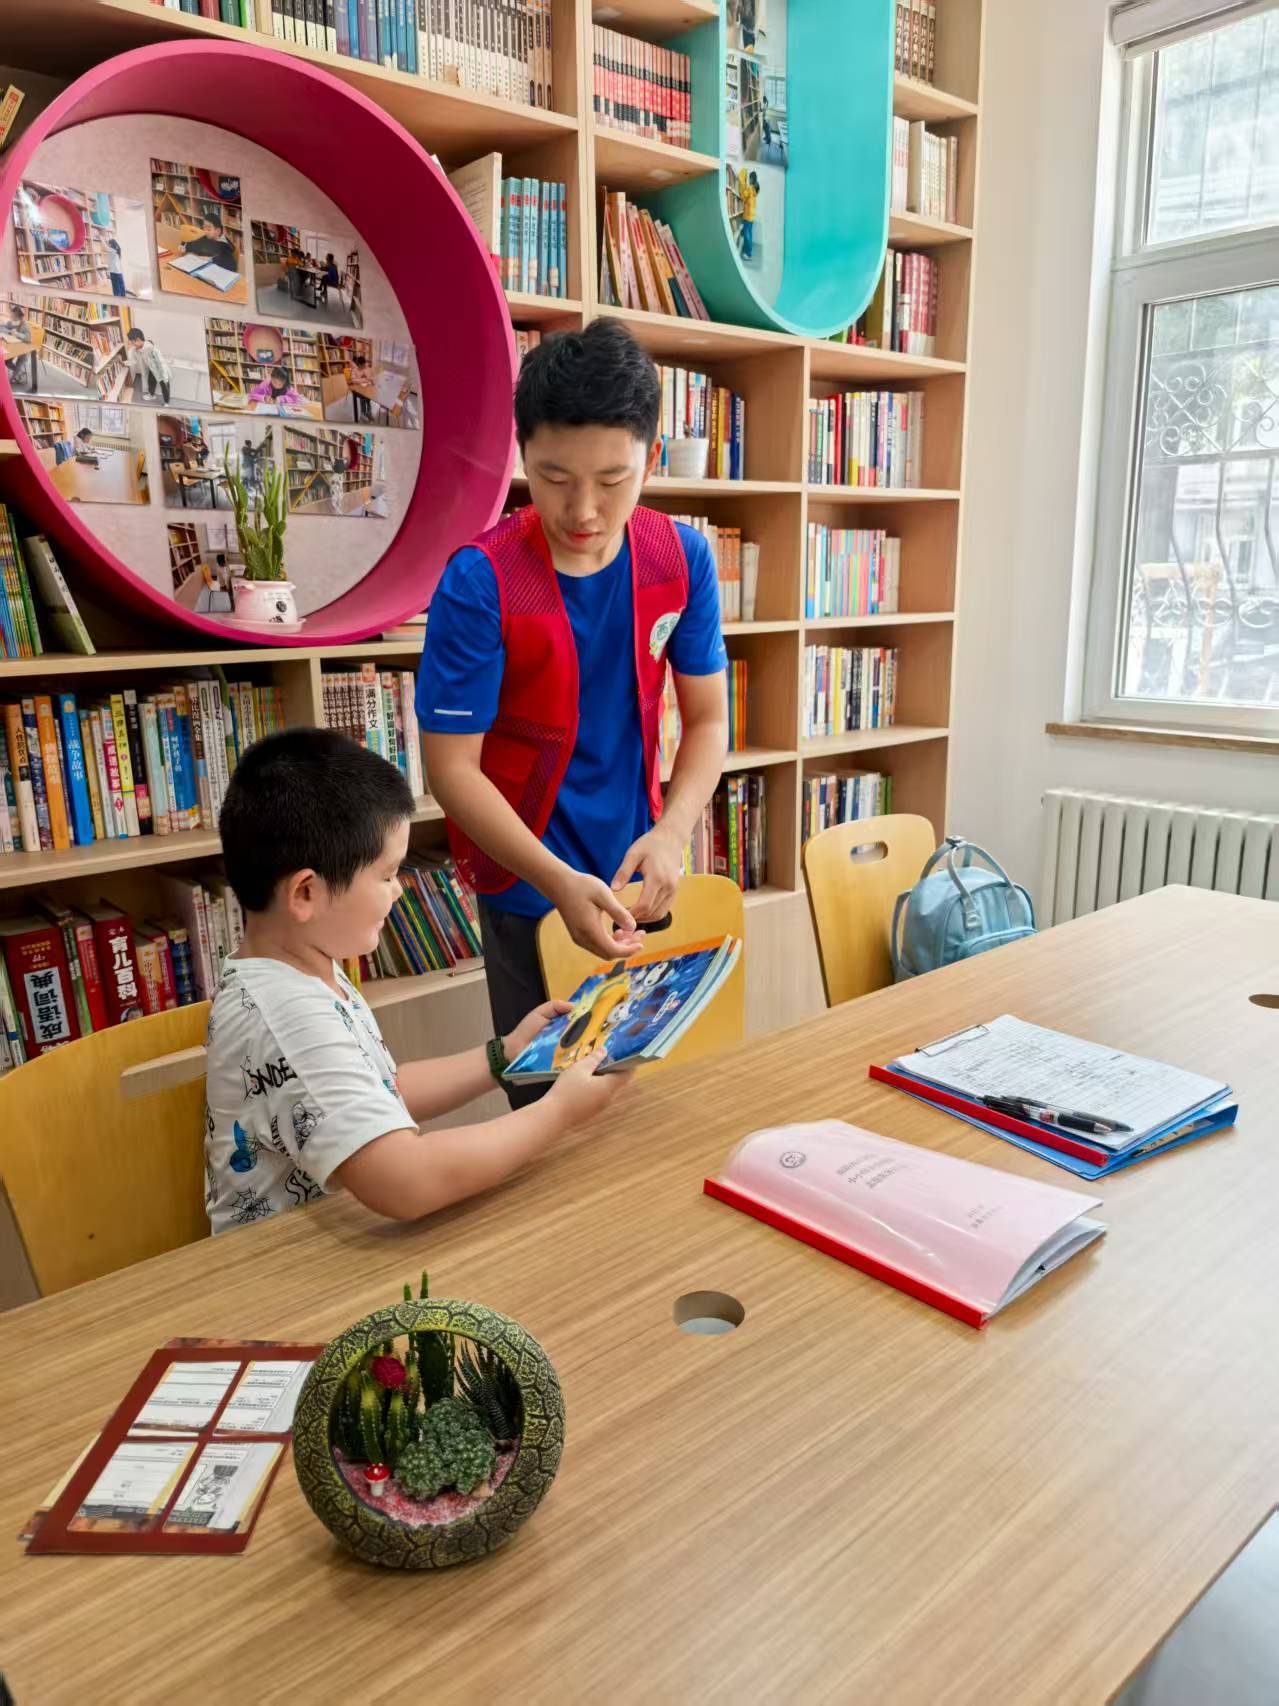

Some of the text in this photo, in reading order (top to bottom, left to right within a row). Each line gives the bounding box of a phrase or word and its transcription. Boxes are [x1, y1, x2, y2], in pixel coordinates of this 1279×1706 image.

[366, 688, 379, 729] 满分作文
[108, 935, 138, 1000] 育儿百科
[30, 970, 62, 1040] 成语词典
